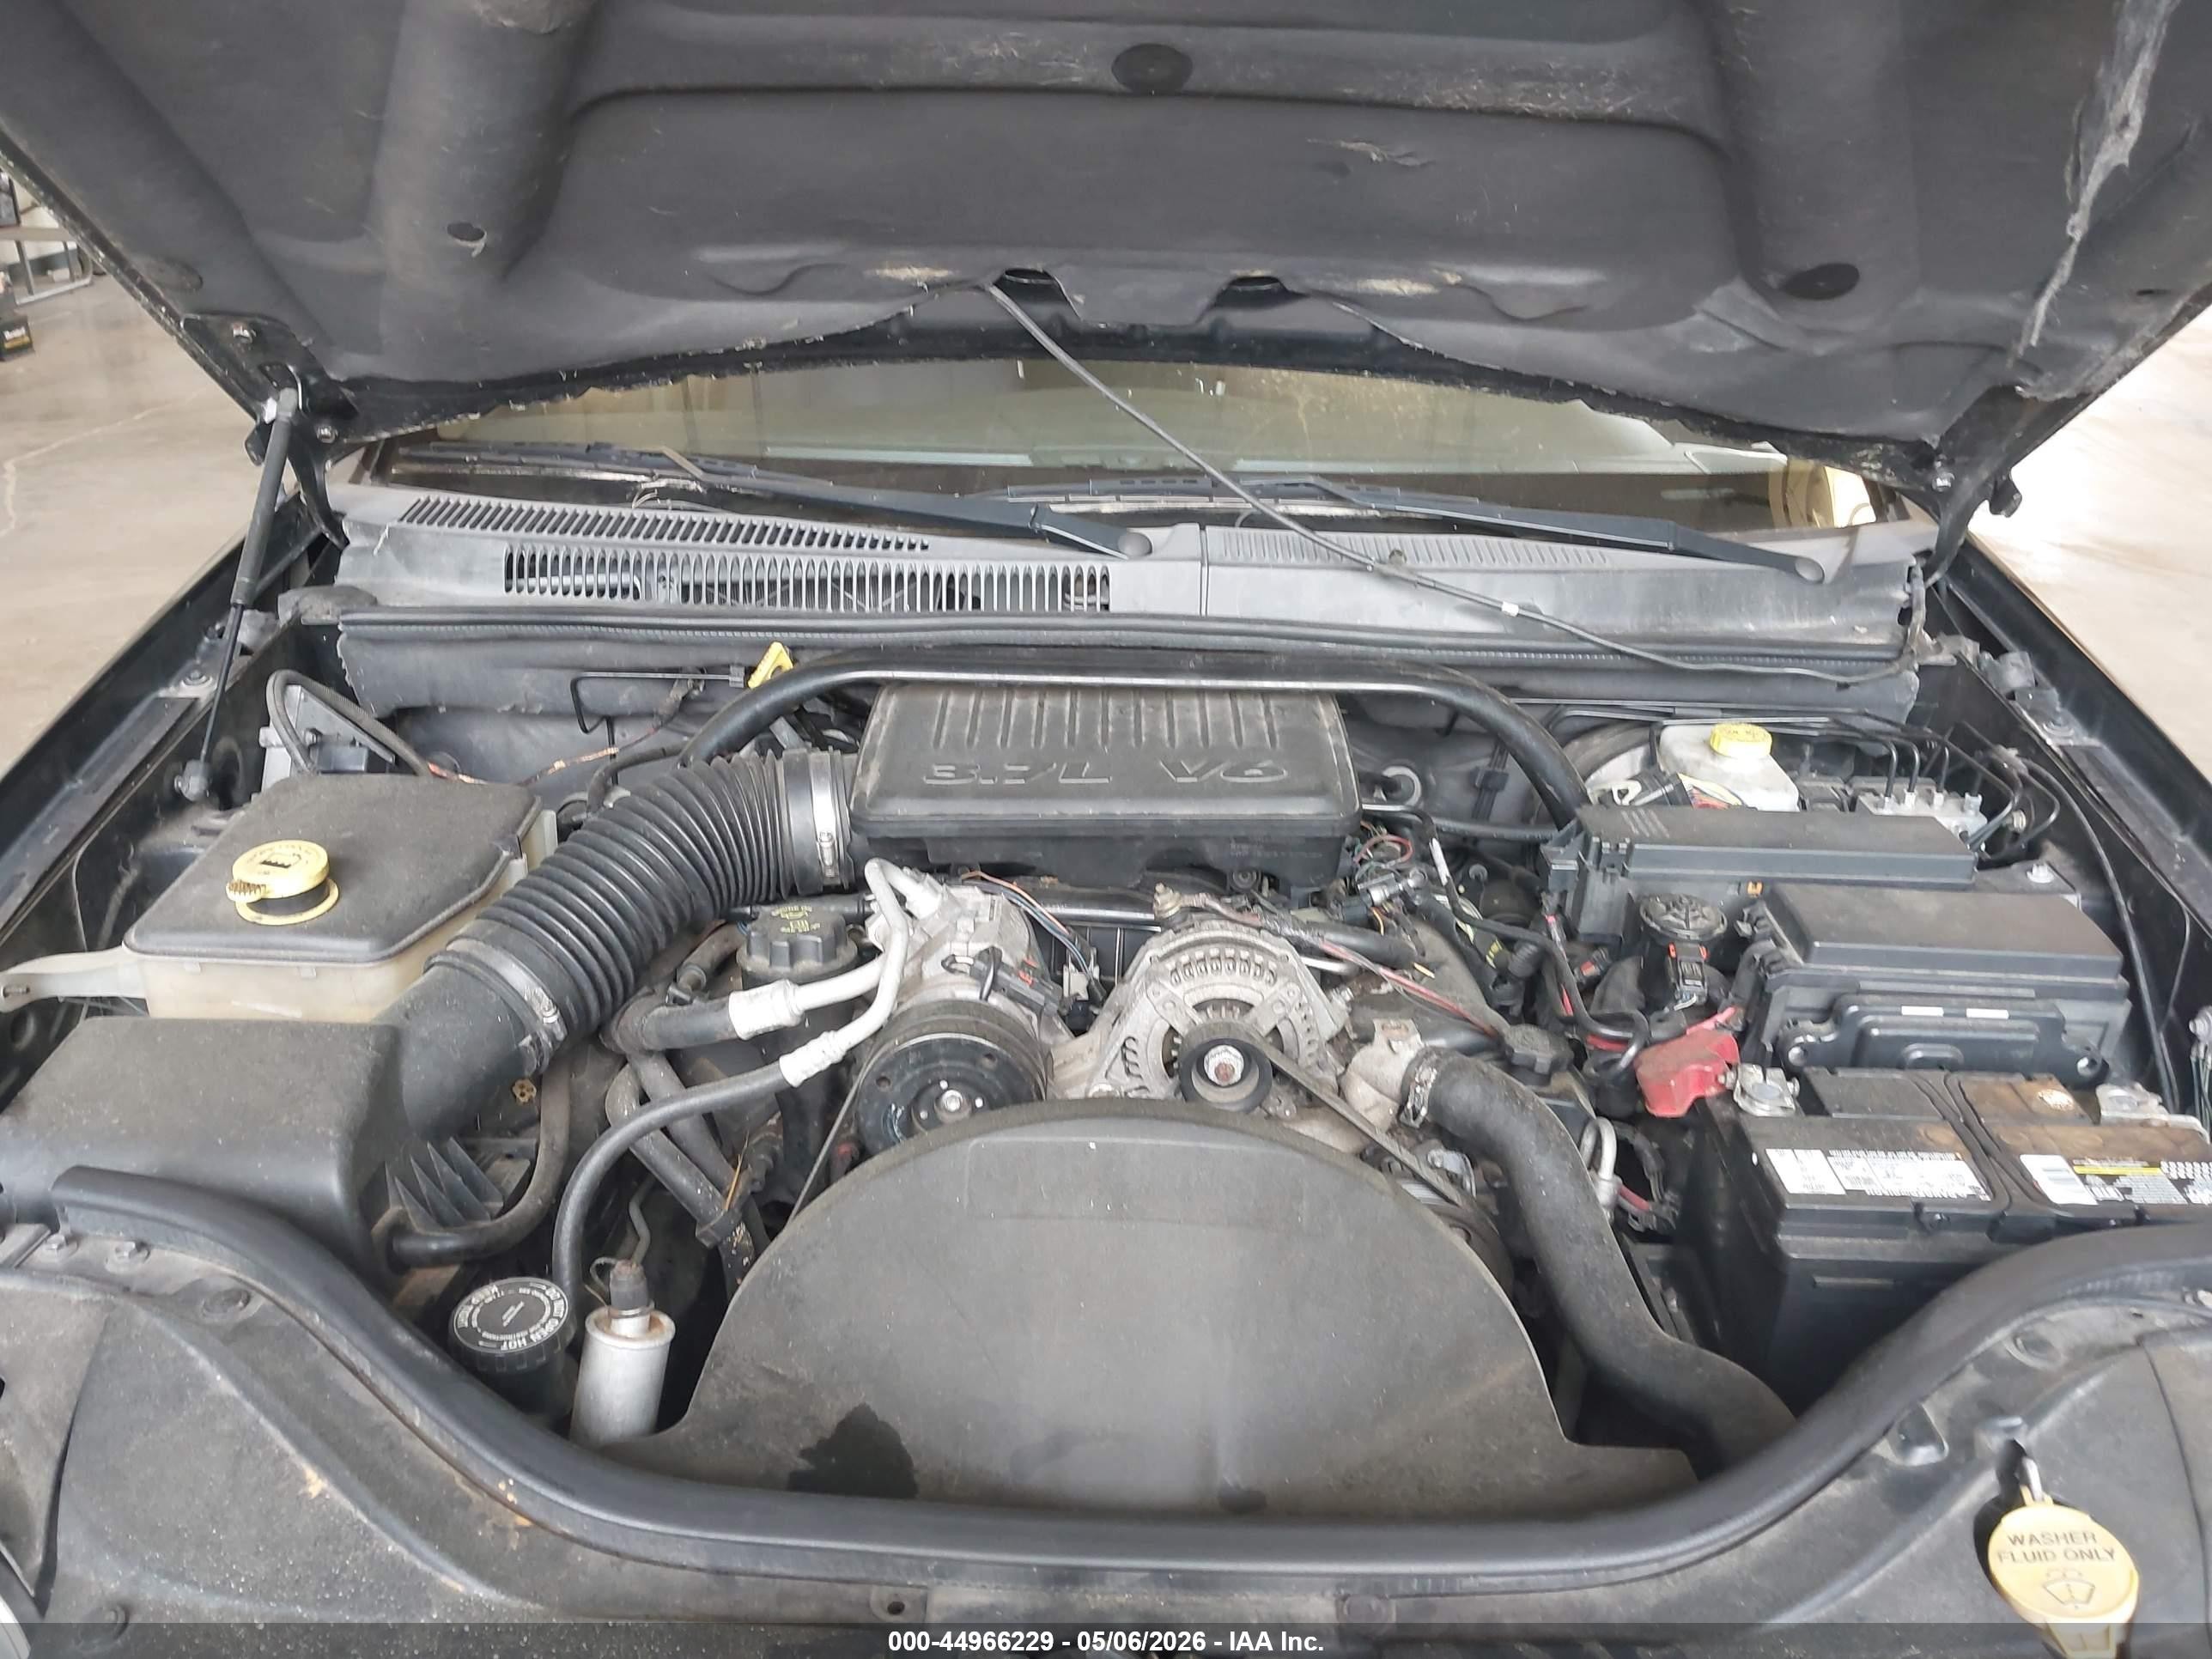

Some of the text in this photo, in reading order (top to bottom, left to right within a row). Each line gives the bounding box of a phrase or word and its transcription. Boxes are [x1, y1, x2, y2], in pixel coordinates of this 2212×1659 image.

[1159, 759, 1289, 783] V6
[501, 1337, 527, 1351] HOT
[2008, 1531, 2097, 1547] WASHER
[1996, 1547, 2115, 1564] FLUID ONLY
